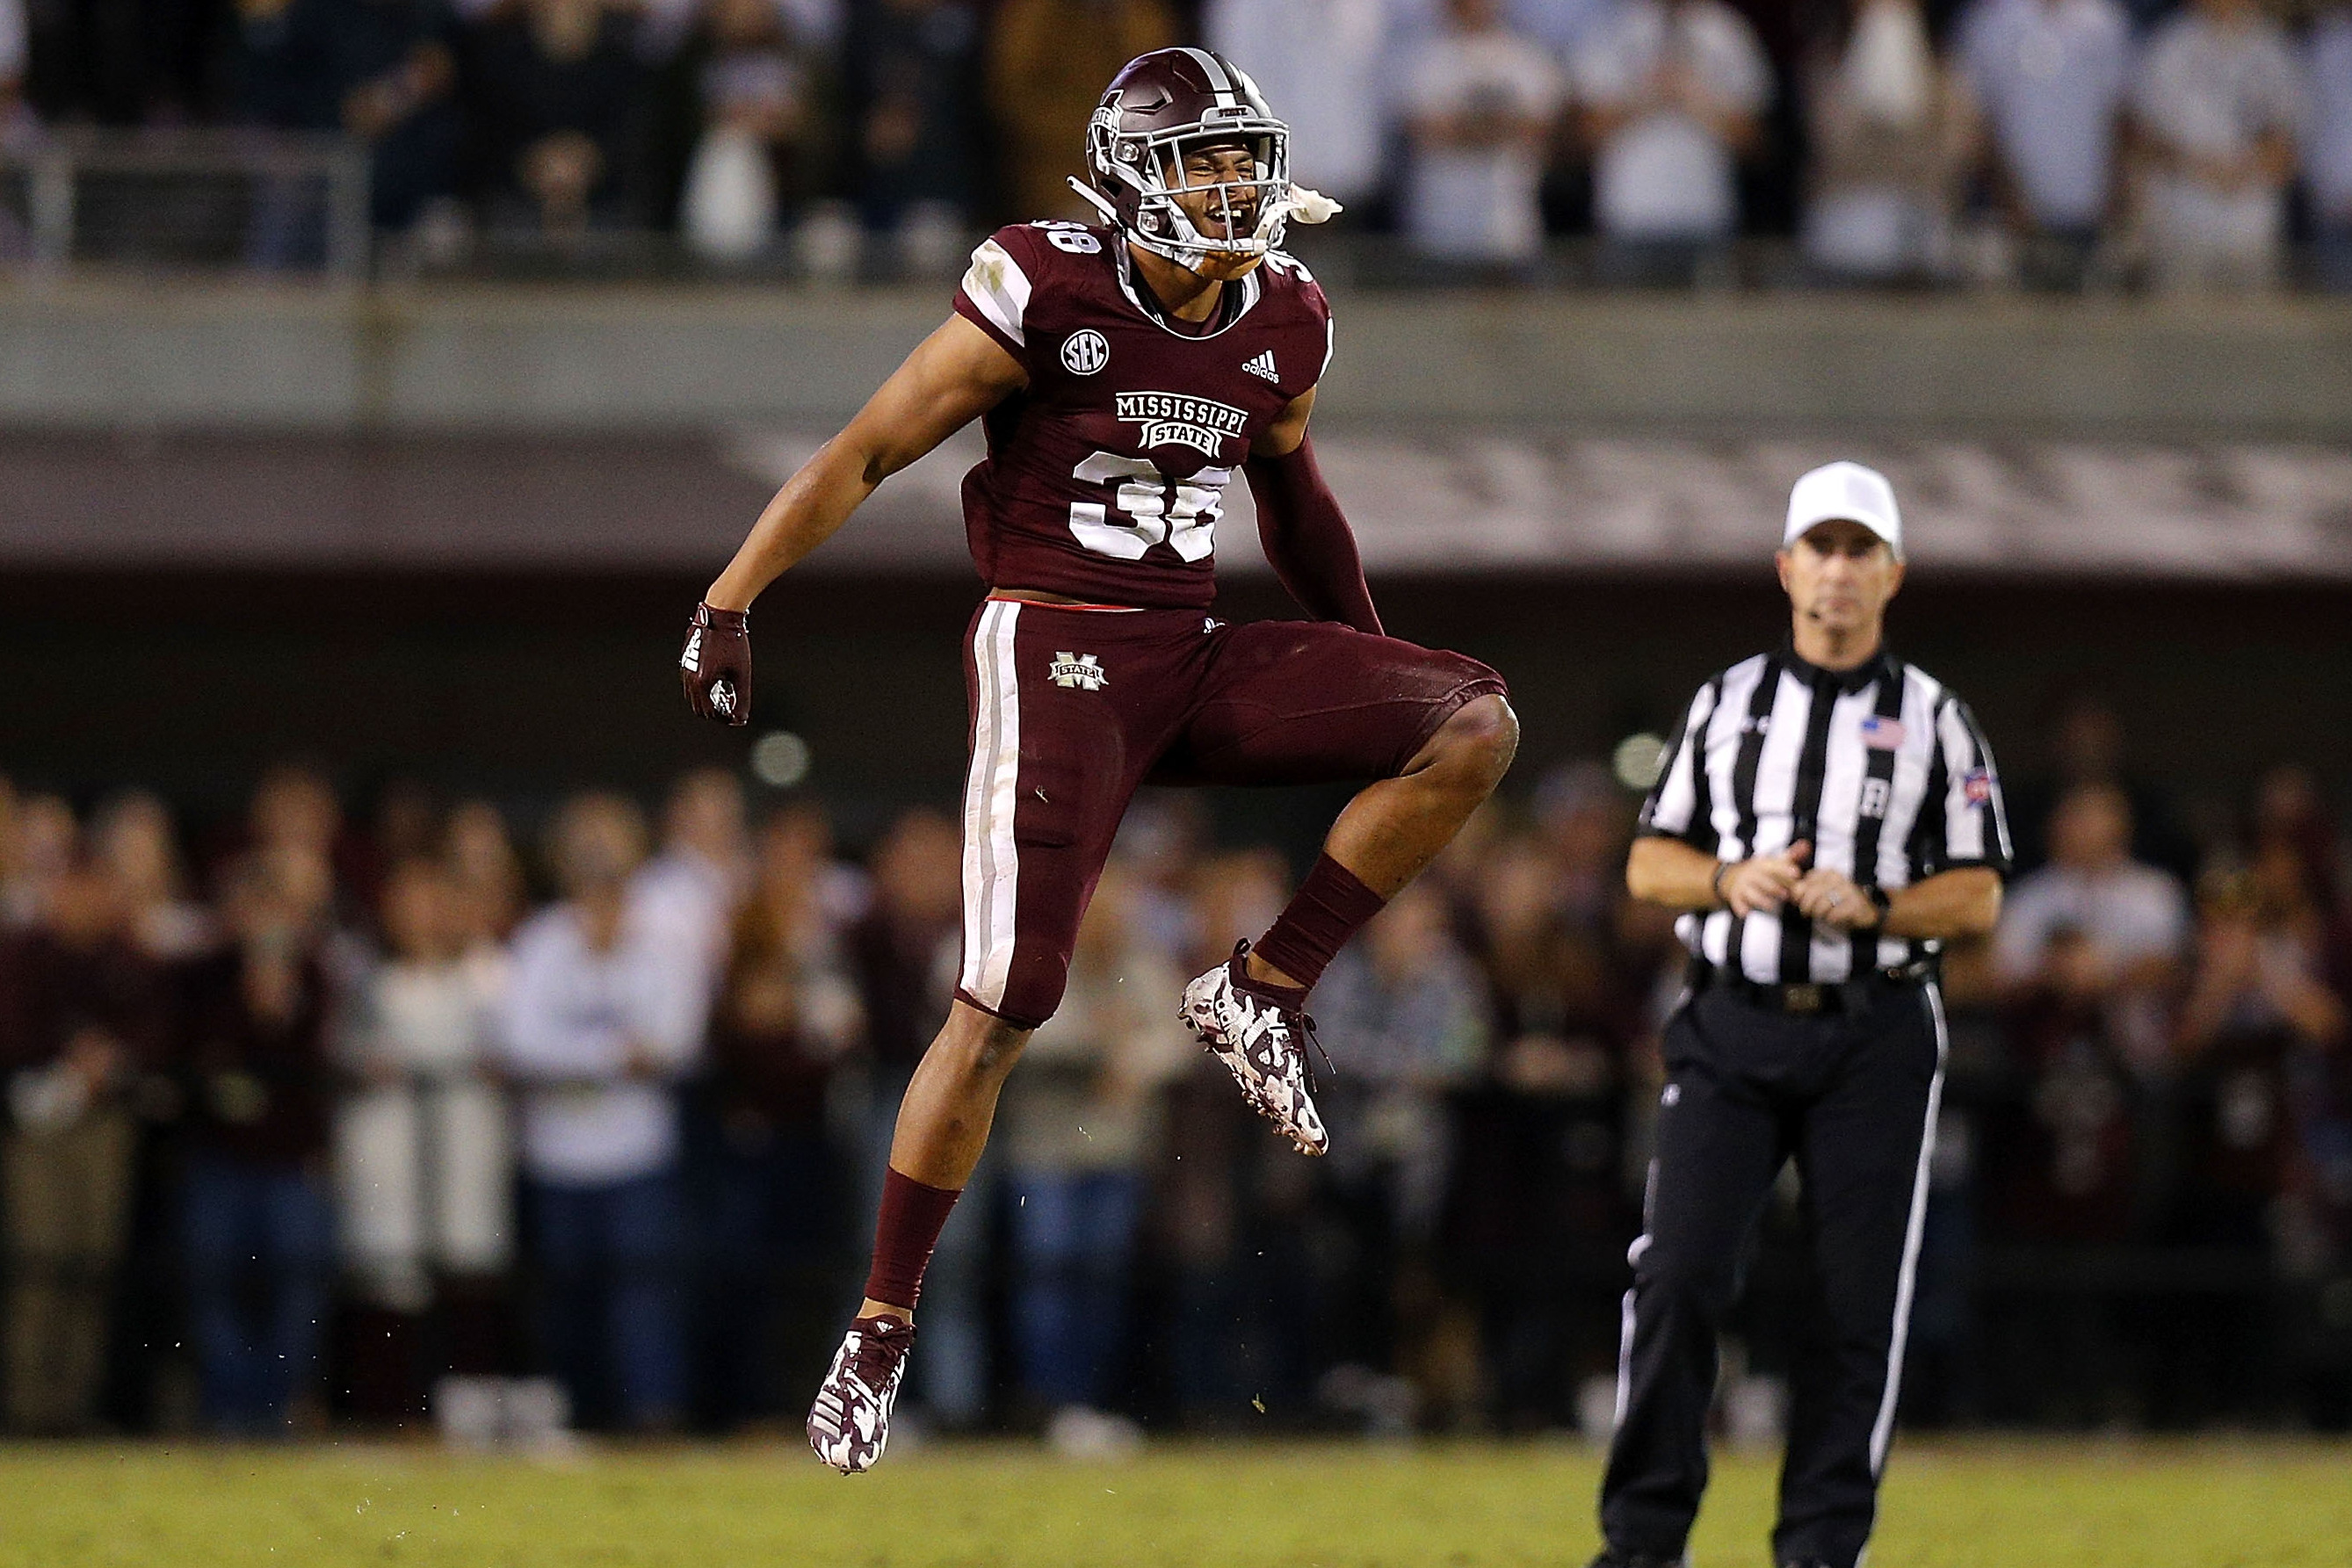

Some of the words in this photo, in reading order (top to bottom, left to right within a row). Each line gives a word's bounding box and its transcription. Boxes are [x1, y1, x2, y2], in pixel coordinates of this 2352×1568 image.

[1066, 333, 1104, 372] SEC
[1241, 362, 1279, 384] adidas
[1115, 395, 1248, 434] MISSISSIPPI
[1154, 425, 1212, 450] STATE
[1060, 664, 1096, 678] STATE
